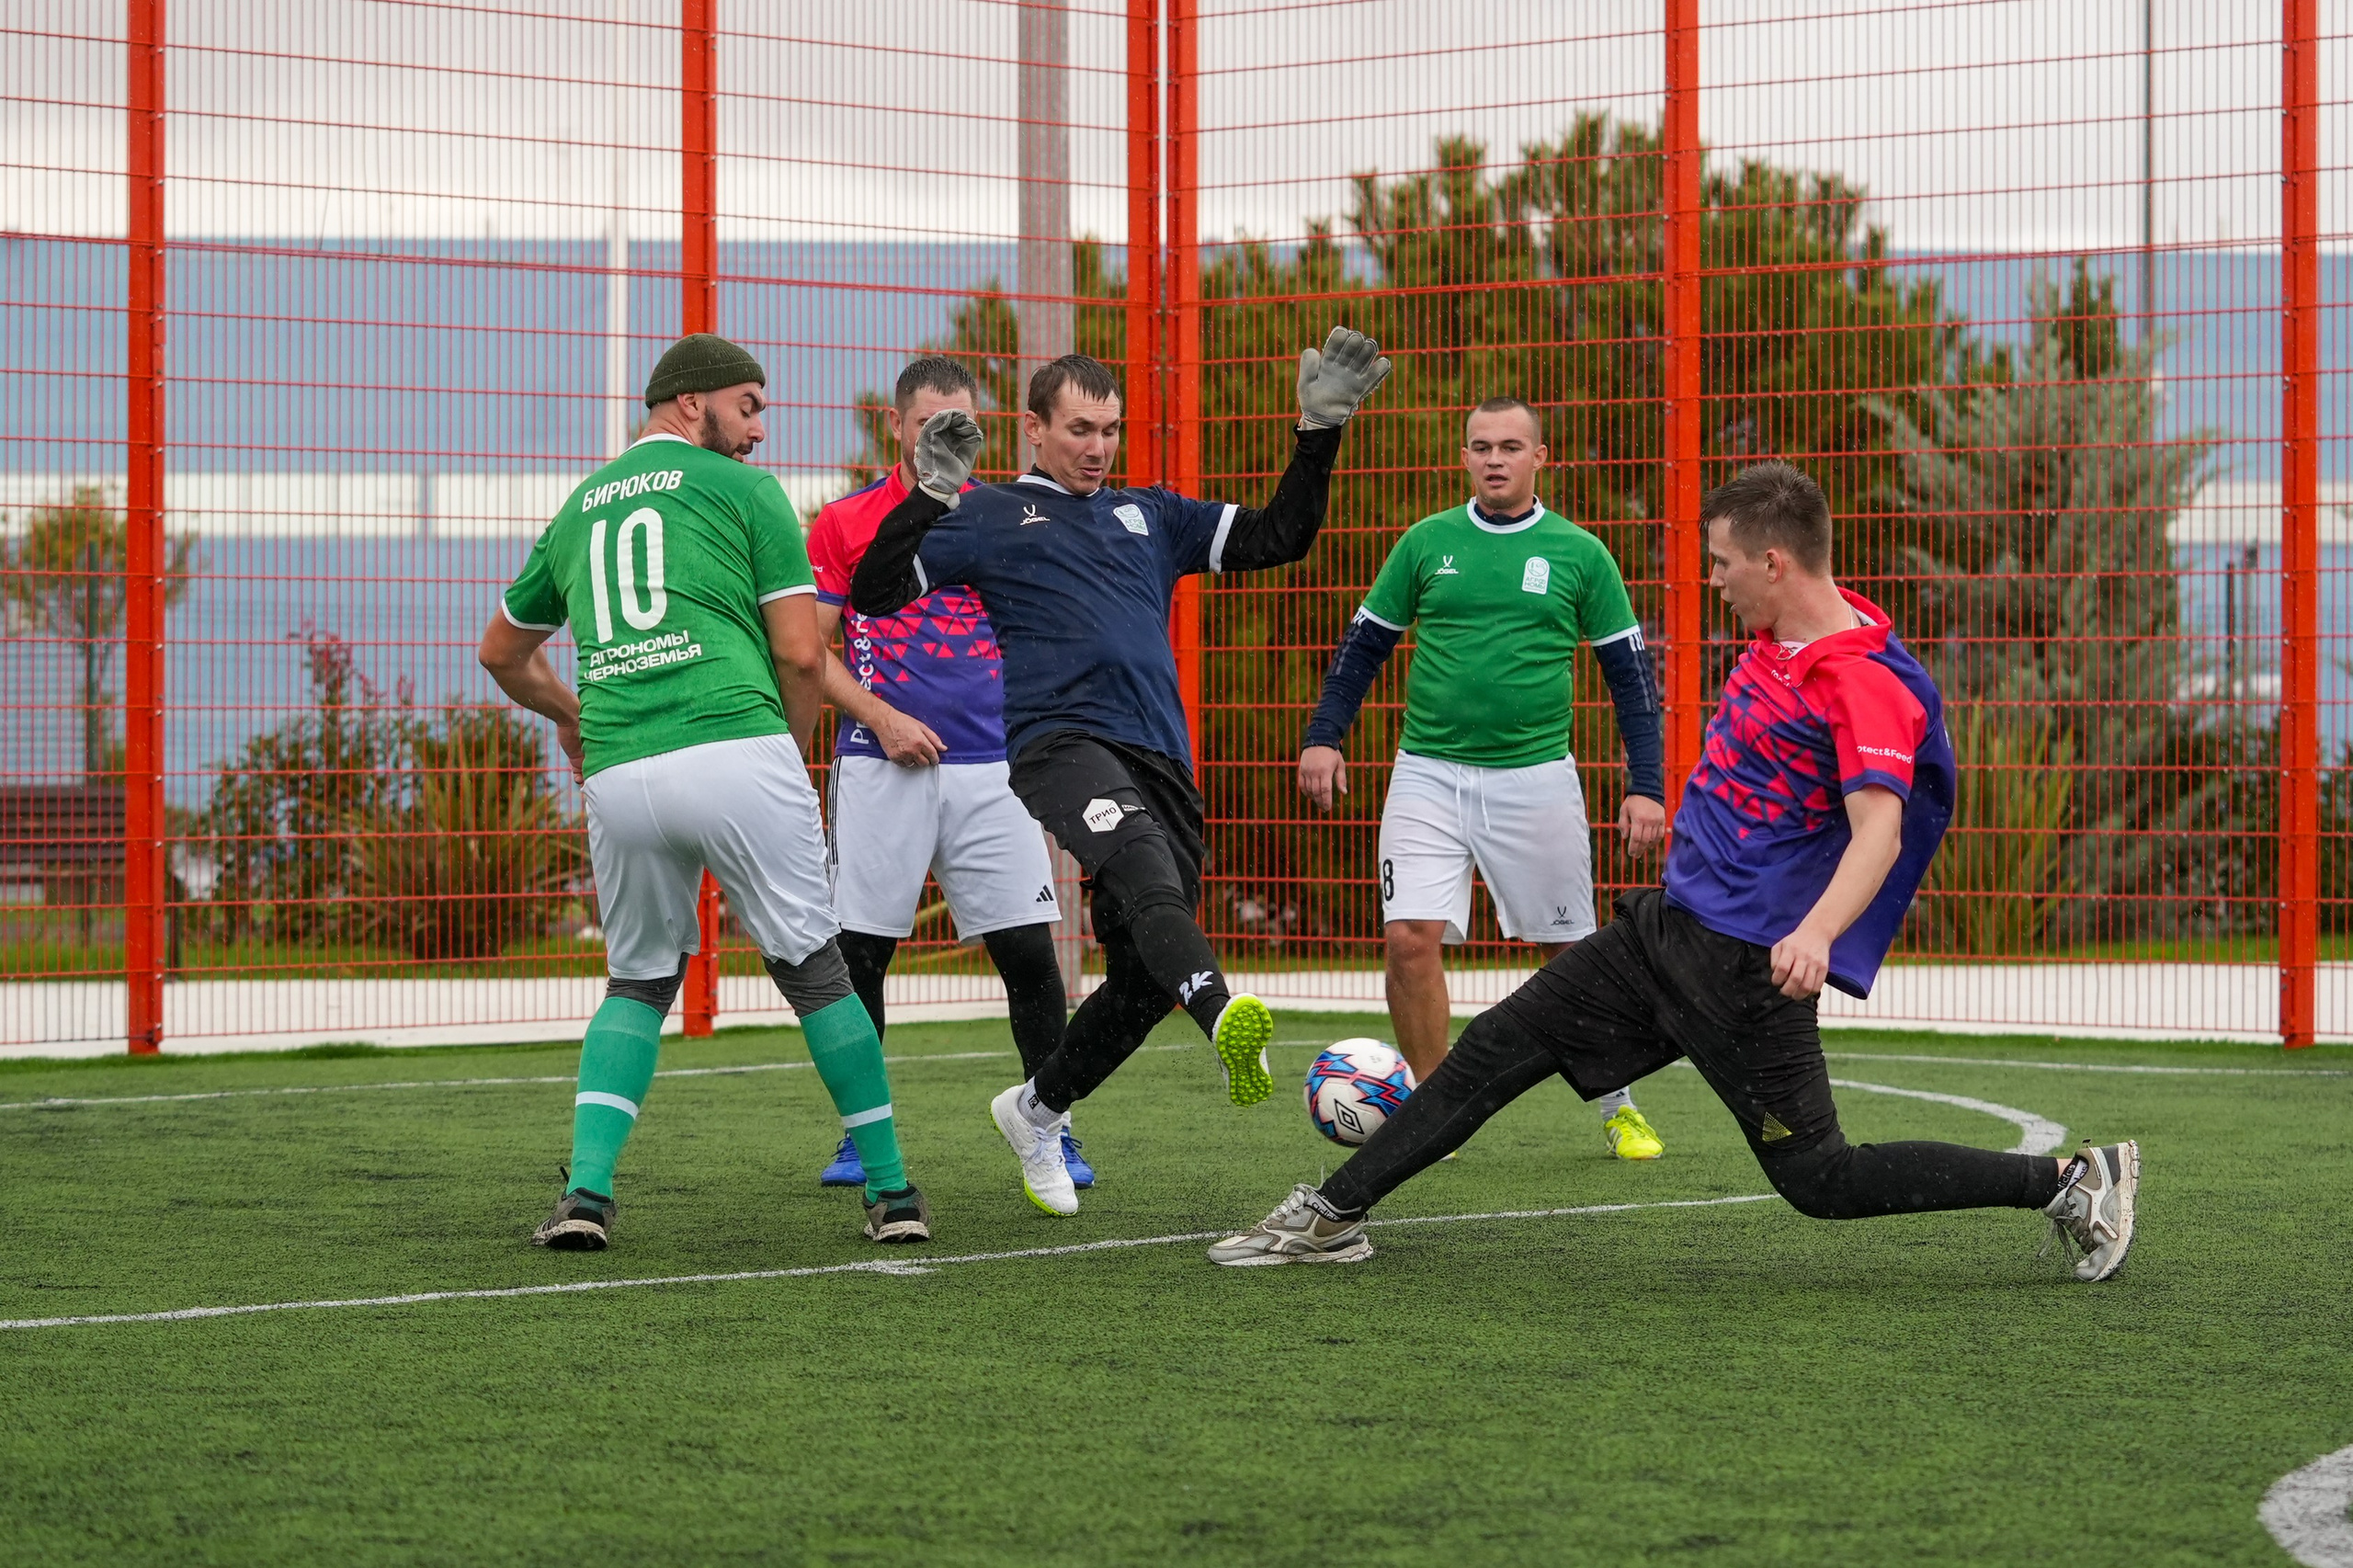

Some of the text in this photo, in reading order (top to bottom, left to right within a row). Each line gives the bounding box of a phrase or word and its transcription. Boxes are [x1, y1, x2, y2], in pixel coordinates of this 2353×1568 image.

[582, 470, 684, 513] БИРЮКОВ
[589, 506, 668, 644] 10
[584, 643, 702, 683] ЧЕРНОЗЕМЬЯ
[589, 630, 690, 668] АГРОНОМЫ
[1857, 745, 1913, 765] otect&Feed
[1089, 806, 1118, 825] ТРИО
[1382, 858, 1394, 902] 8
